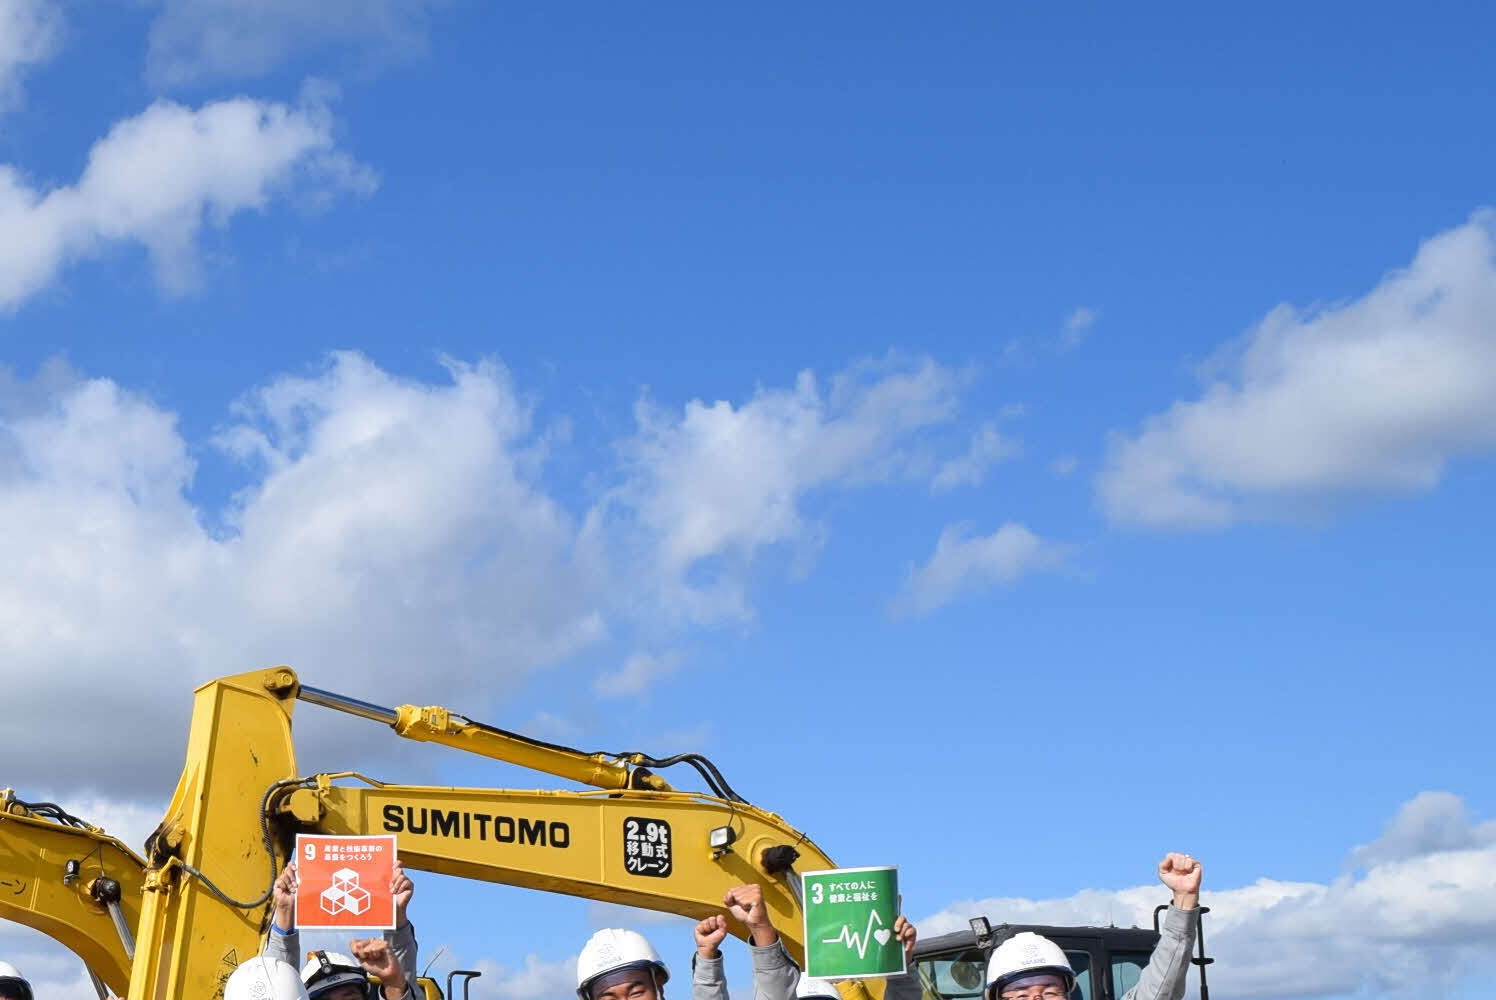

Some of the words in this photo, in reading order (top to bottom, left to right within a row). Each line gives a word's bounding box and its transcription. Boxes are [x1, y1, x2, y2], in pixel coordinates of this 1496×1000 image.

[383, 804, 570, 849] SUMITOMO
[626, 820, 668, 843] 2.9t
[304, 843, 316, 861] 9
[626, 841, 669, 859] 移動式
[627, 857, 669, 874] クレーン
[811, 882, 824, 905] 3
[829, 880, 877, 891] すべての人に
